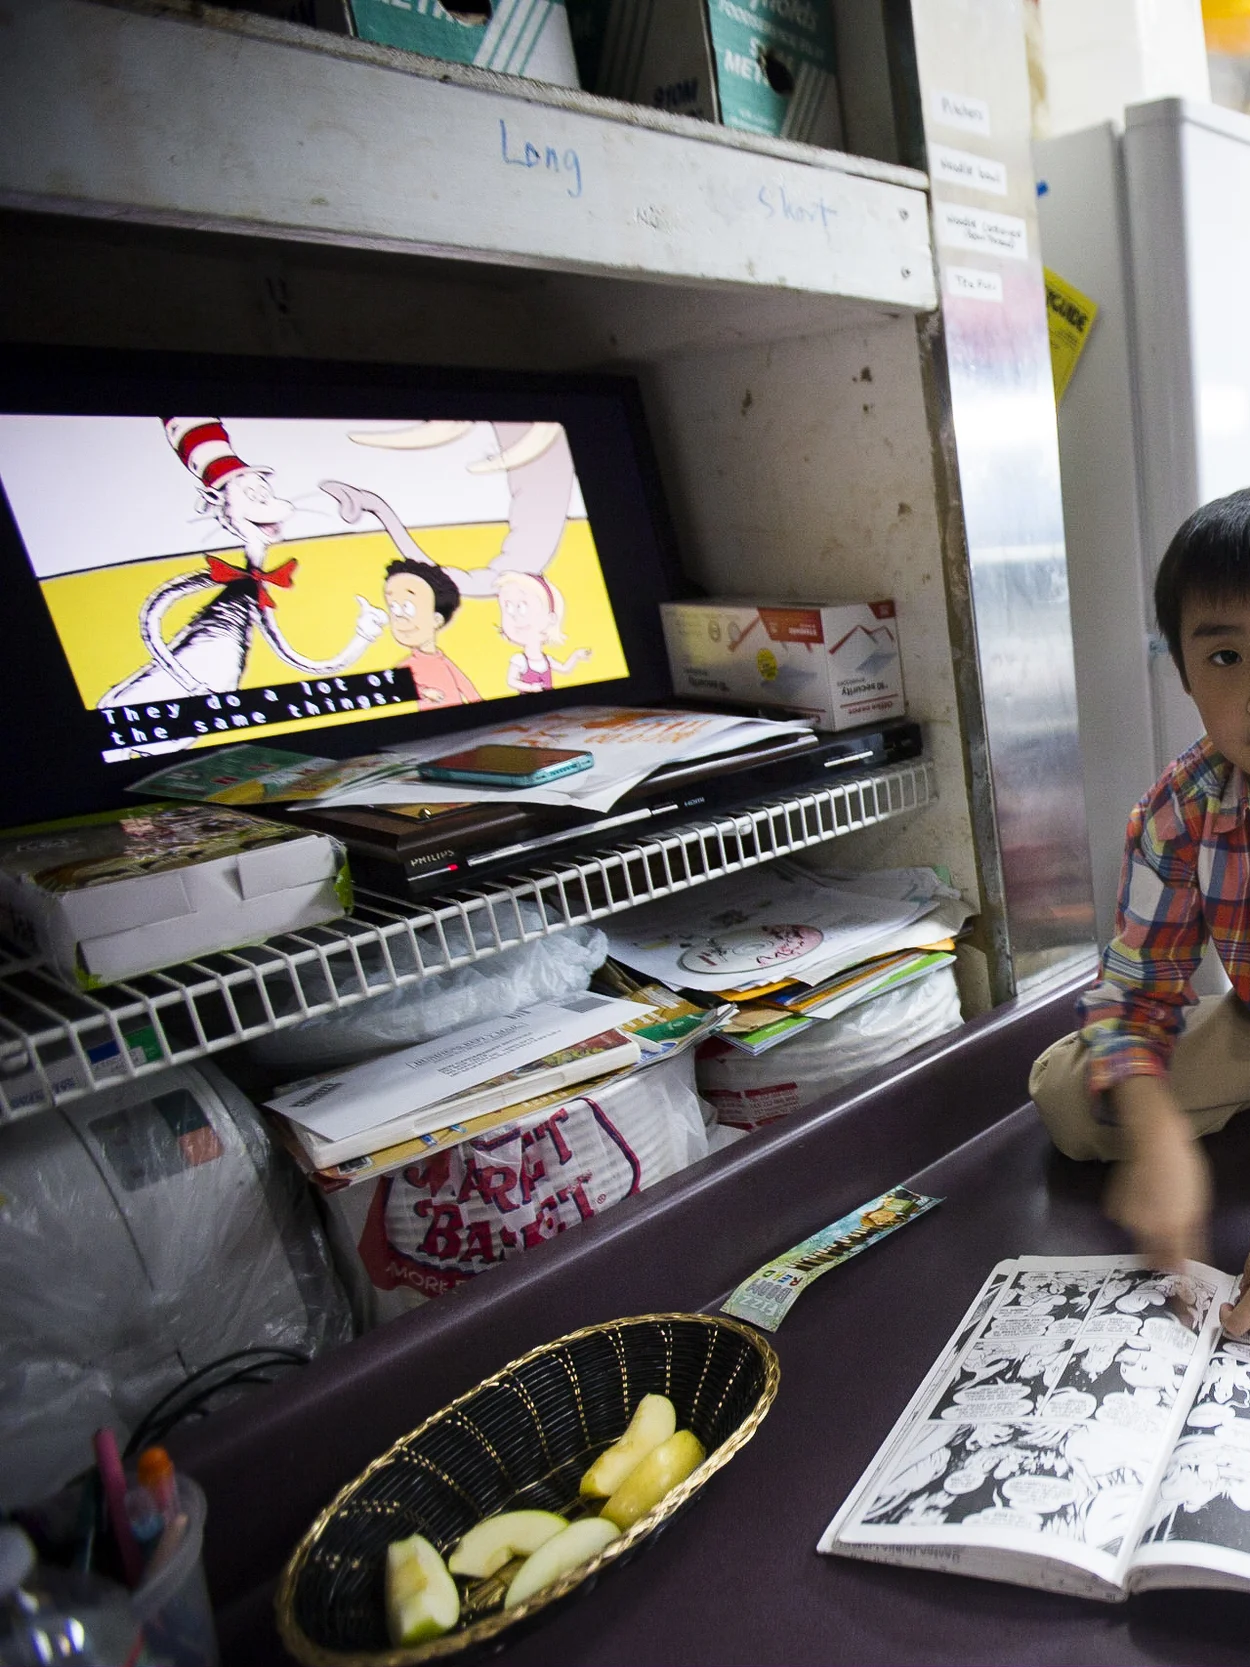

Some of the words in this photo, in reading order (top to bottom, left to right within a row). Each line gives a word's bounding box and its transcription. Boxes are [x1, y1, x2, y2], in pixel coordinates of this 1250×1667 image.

[499, 118, 583, 198] Long
[101, 702, 180, 726] They
[207, 692, 241, 711] do
[263, 687, 279, 703] a
[301, 676, 349, 697] lot
[365, 668, 396, 688] of
[841, 682, 876, 697] security
[109, 726, 169, 746] the
[193, 710, 267, 734] same
[287, 691, 401, 716] things.
[410, 849, 455, 867] PHILIPS
[745, 1277, 793, 1304] BOOM
[762, 1269, 804, 1287] READ
[740, 1293, 780, 1317] FIZZ
